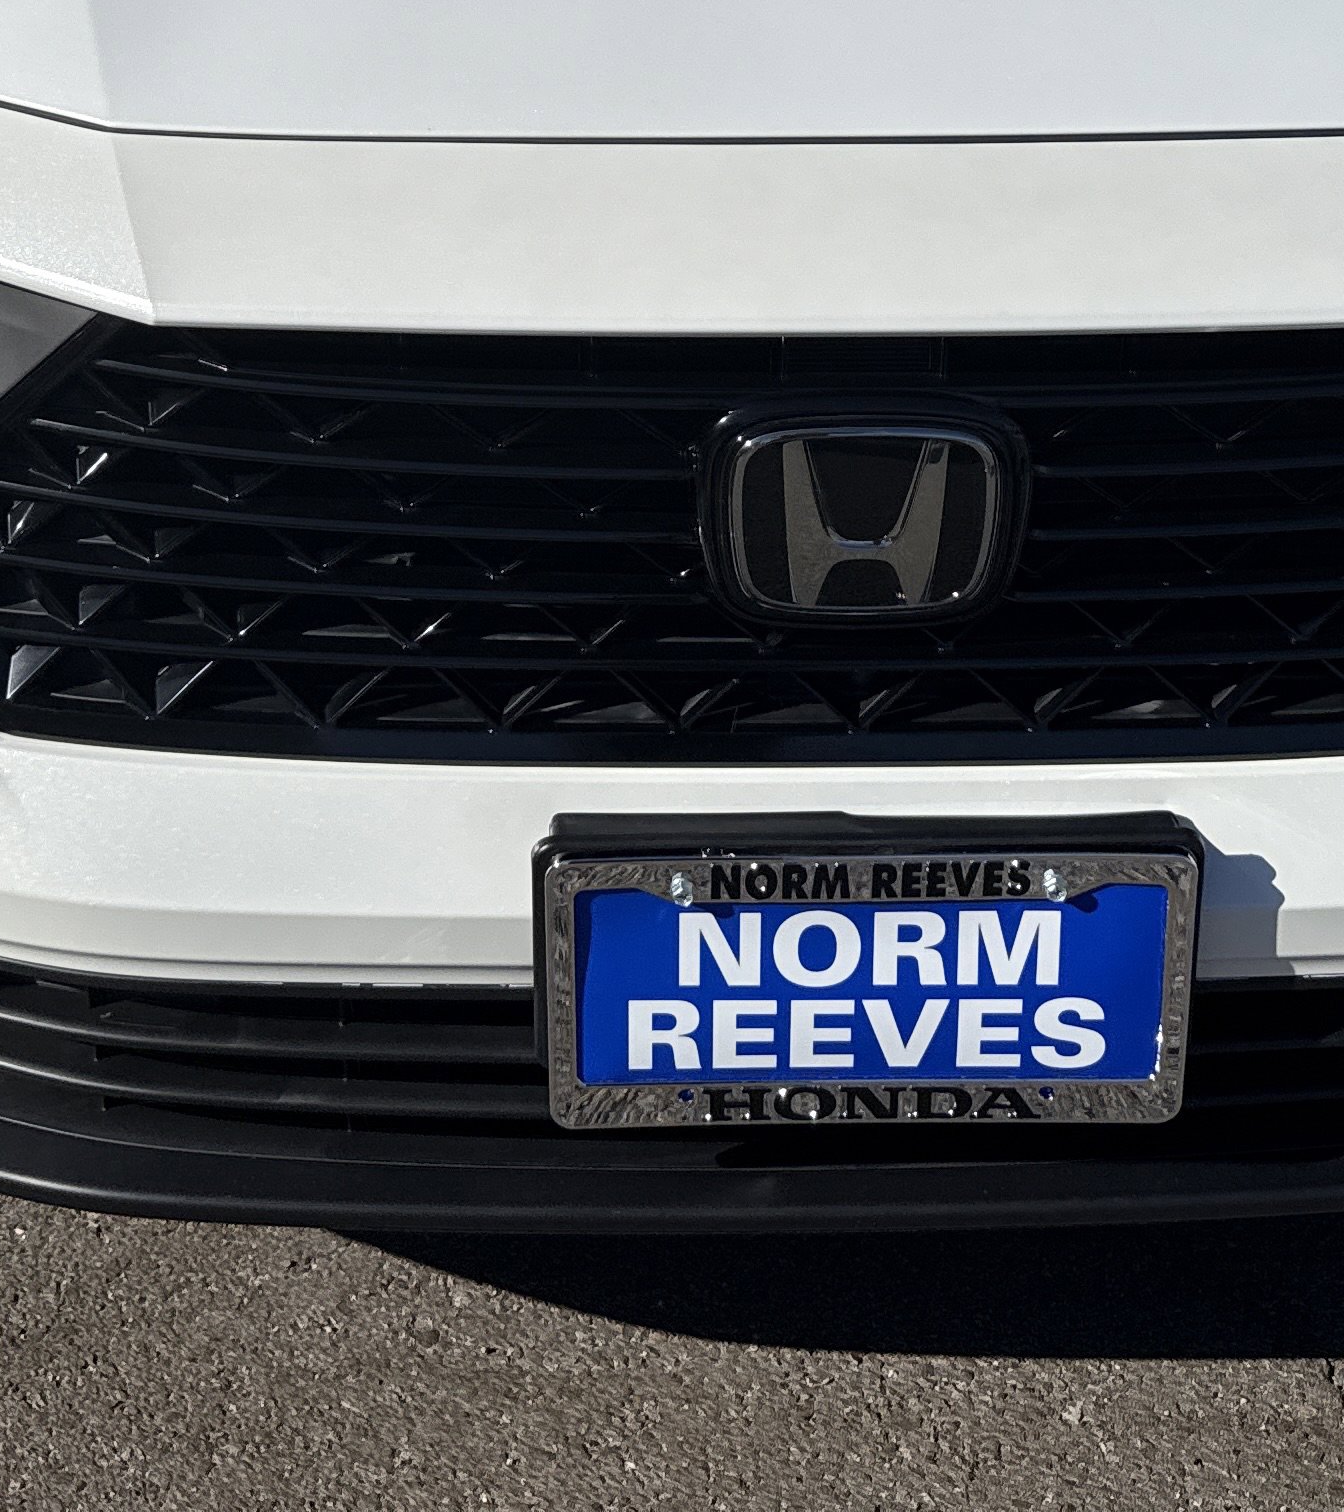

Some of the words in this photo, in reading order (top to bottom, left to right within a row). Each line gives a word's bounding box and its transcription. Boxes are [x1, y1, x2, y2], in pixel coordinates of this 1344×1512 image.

[709, 862, 851, 900] NORM
[871, 860, 1031, 899] REEVES
[678, 909, 1062, 988] NORM
[628, 996, 1106, 1070] REEVES
[702, 1087, 1041, 1121] HONDA
